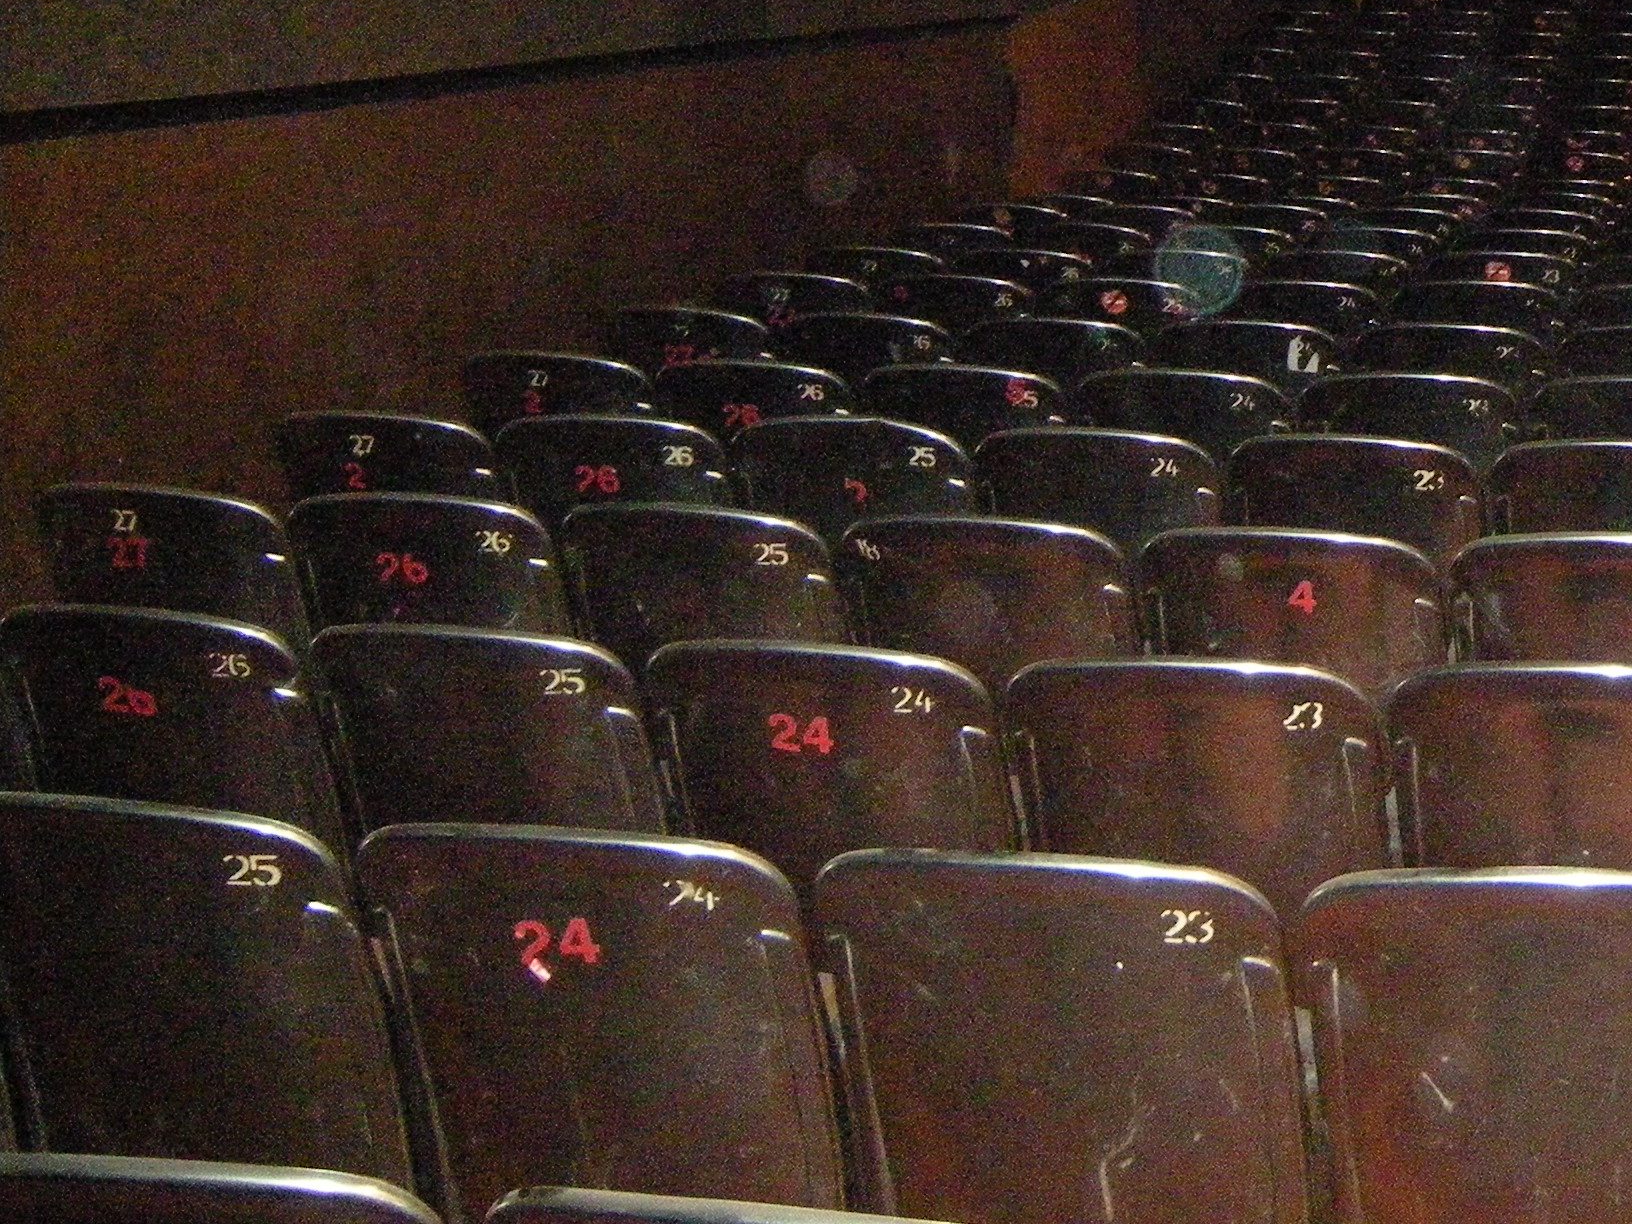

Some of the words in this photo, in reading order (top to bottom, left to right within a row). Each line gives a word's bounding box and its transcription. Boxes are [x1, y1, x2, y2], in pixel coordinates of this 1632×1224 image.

[349, 434, 375, 456] 27
[662, 445, 695, 468] 26
[909, 446, 937, 469] 25
[1150, 456, 1178, 478] 24
[111, 509, 138, 533] 27
[475, 529, 514, 555] 26
[753, 542, 790, 567] 25
[1289, 580, 1317, 615] 4
[539, 667, 586, 695] 25
[890, 686, 935, 714] 24
[1283, 701, 1323, 732] 23
[767, 712, 836, 755] 24
[221, 852, 285, 888] 25
[1160, 908, 1215, 945] 23
[512, 916, 603, 967] 24
